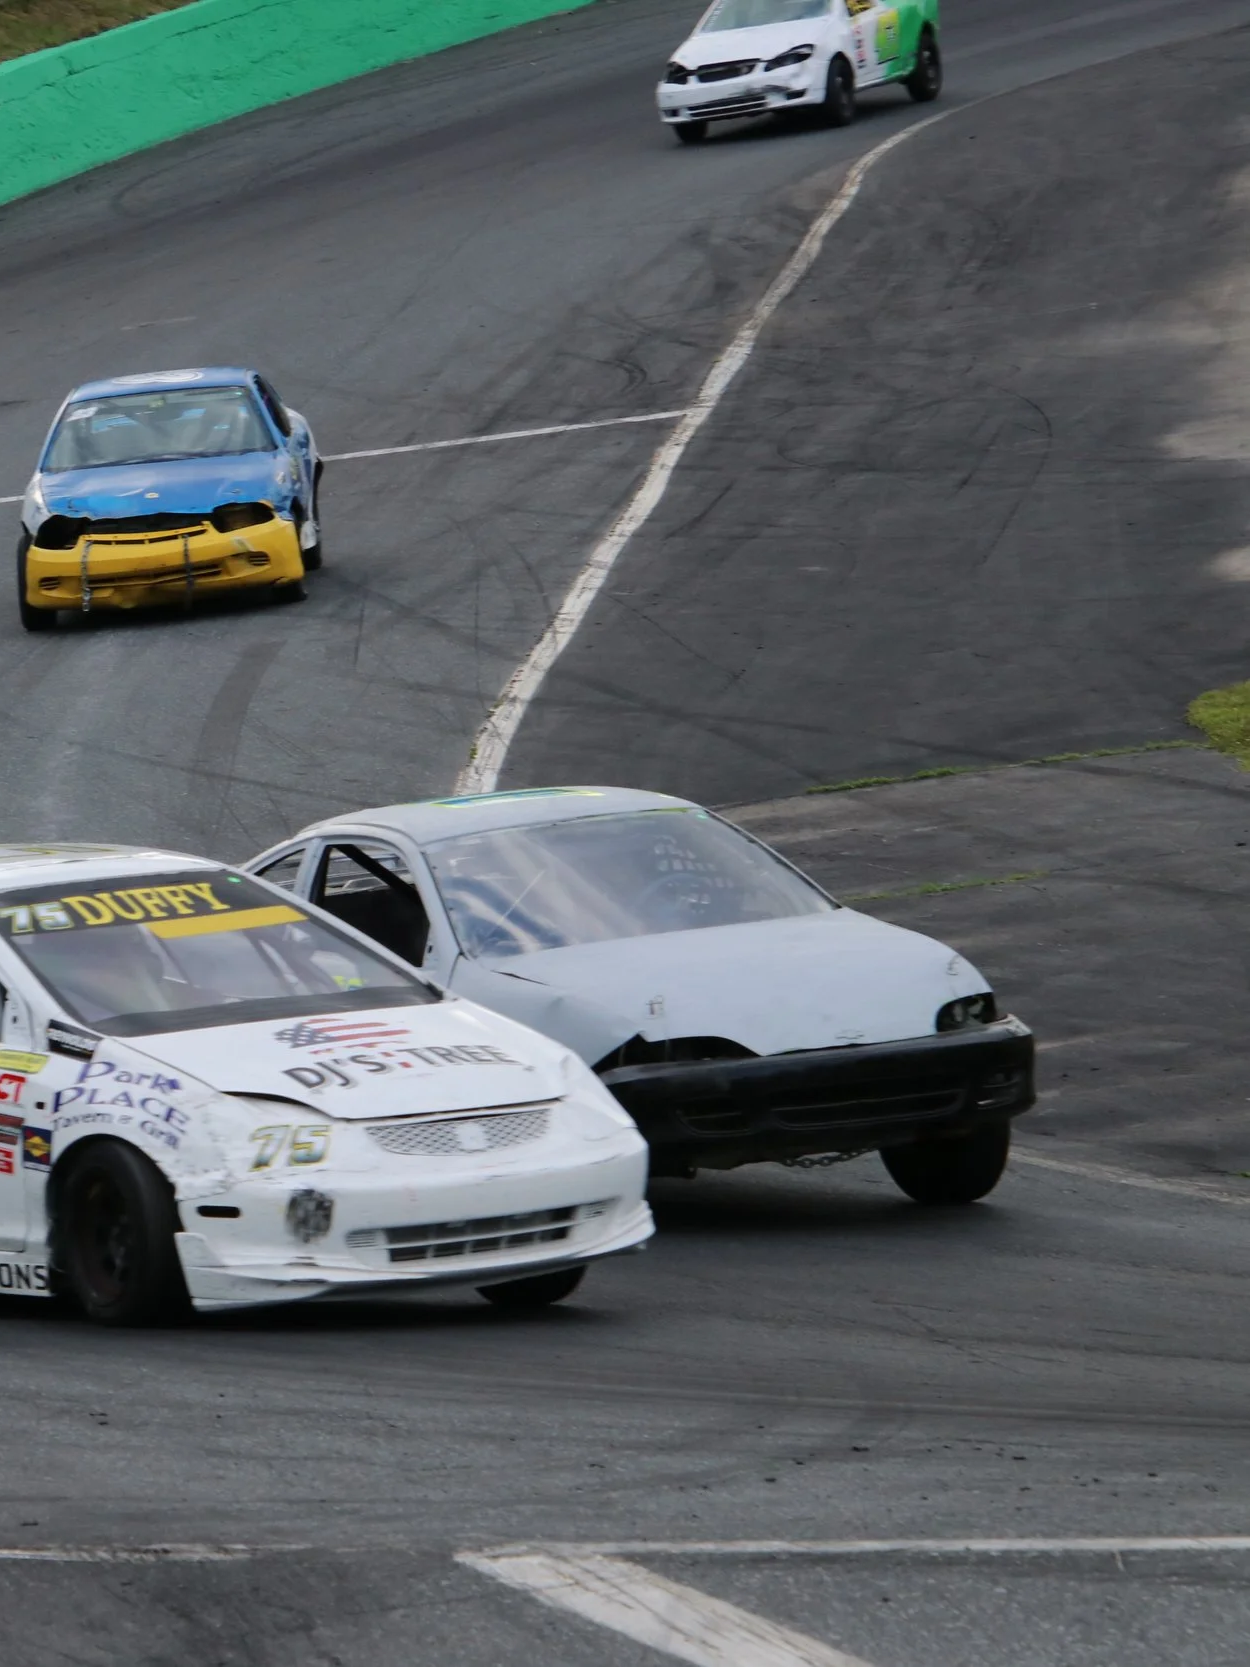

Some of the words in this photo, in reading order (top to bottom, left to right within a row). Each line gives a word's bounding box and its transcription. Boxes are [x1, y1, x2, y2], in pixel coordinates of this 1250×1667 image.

[62, 882, 230, 925] DUFFY
[75, 1061, 175, 1093] Park
[282, 1053, 390, 1090] DJ'S
[396, 1044, 523, 1067] TREE
[52, 1086, 191, 1136] PLACE
[250, 1123, 332, 1172] 75
